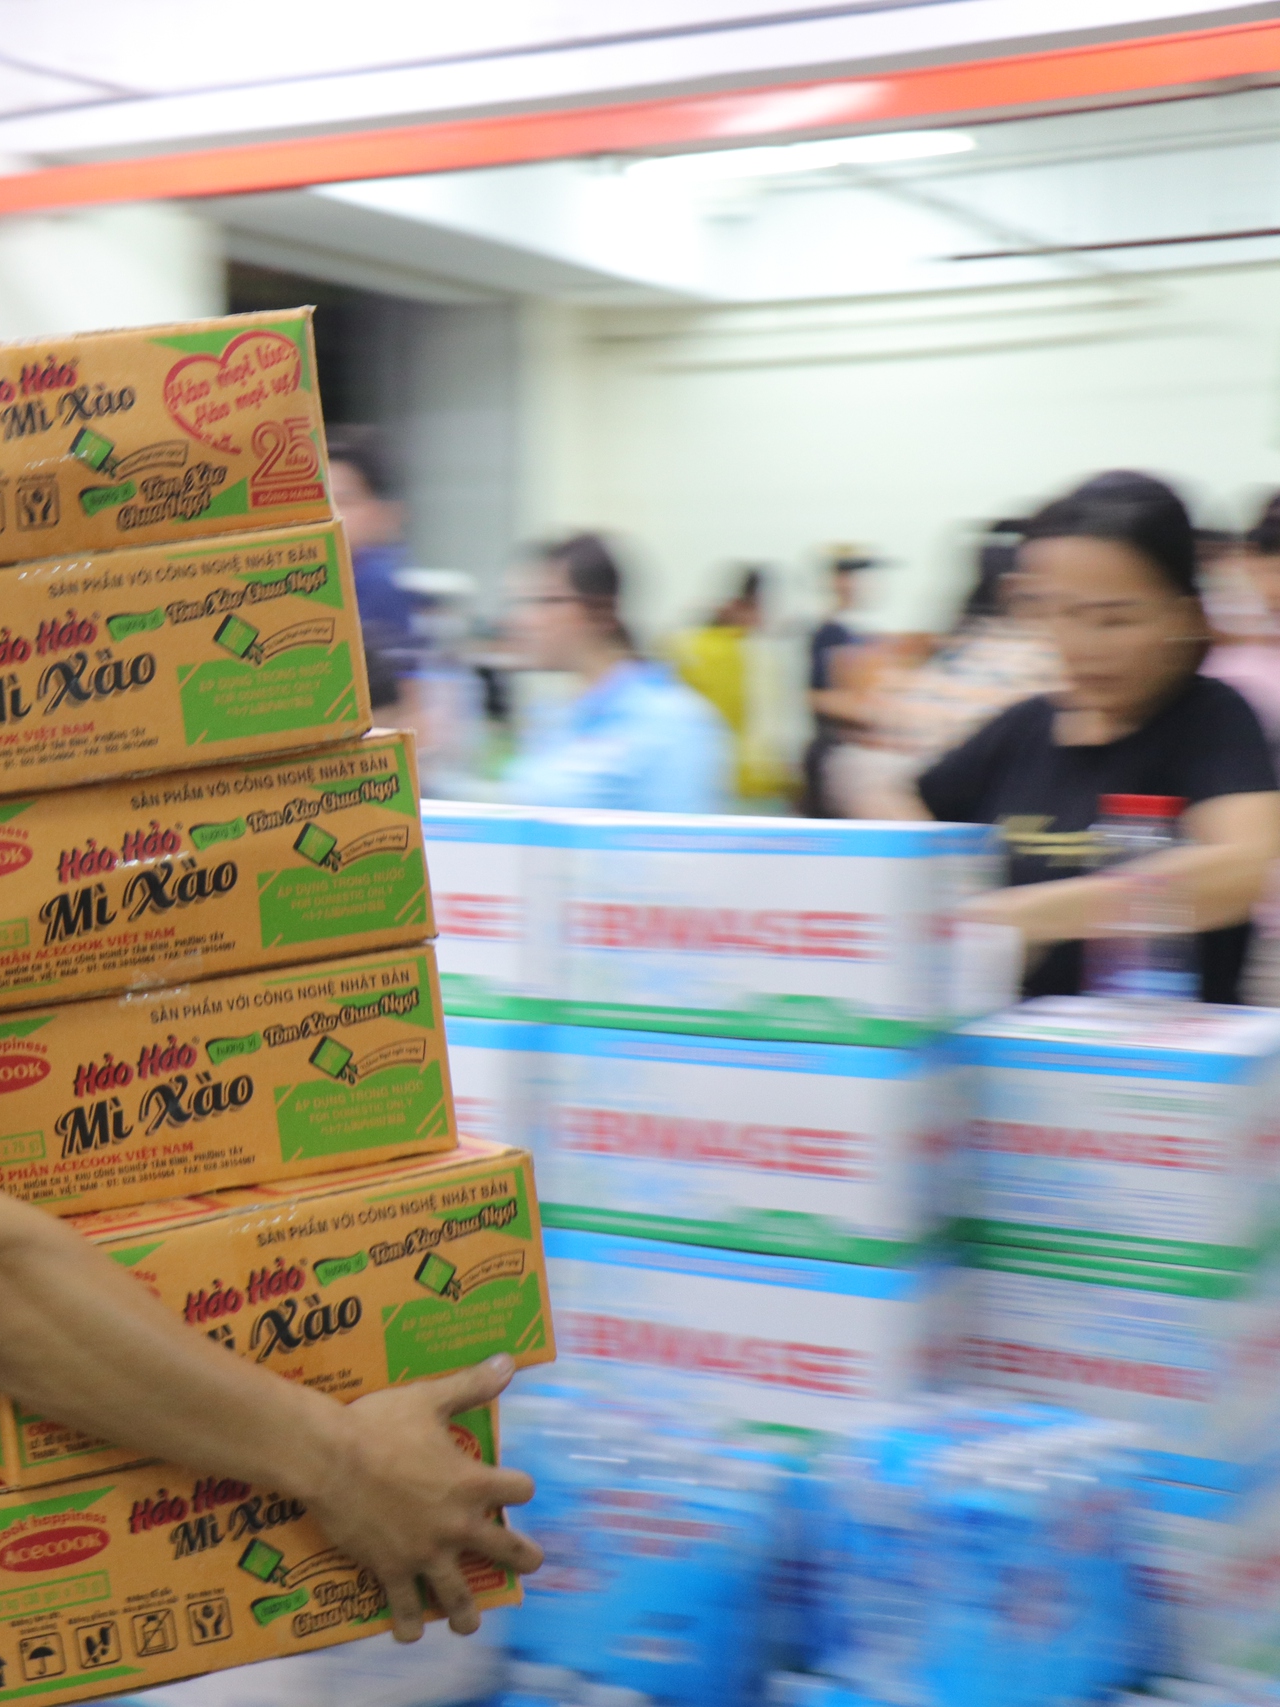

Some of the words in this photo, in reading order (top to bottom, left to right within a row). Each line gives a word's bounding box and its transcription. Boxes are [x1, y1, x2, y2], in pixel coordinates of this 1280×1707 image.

[20, 353, 80, 397] Hảo
[56, 382, 138, 429] Xào
[250, 416, 319, 490] 25
[155, 560, 197, 584] CÔNG
[36, 608, 99, 657] Hảo
[36, 648, 157, 715] Xào
[131, 791, 161, 811] SẢN
[164, 782, 204, 806] PHẨM
[207, 779, 231, 799] VỚI
[234, 774, 272, 793] CÔNG
[277, 768, 315, 786] NGHỆ
[319, 762, 356, 780] NHẬT
[360, 755, 388, 771] BẢN
[247, 808, 285, 834] Tôm
[283, 797, 322, 824] Xào
[320, 787, 362, 813] Chua
[359, 773, 400, 804] Ngọt
[58, 838, 119, 884] Hảo
[121, 820, 182, 863] Hảo
[39, 882, 118, 946] Mì
[122, 857, 239, 922] Xào
[107, 930, 139, 948] VIỆT
[143, 925, 176, 940] NAM
[150, 1003, 180, 1025] SẢN
[183, 995, 223, 1018] PHẨM
[227, 992, 251, 1012] VỚI
[254, 988, 294, 1007] CÔNG
[298, 981, 337, 1002] NGHỆ
[341, 973, 377, 994] NHẬT
[381, 968, 411, 985] BẢN
[263, 1022, 301, 1048] Tôm
[299, 1010, 339, 1039] Xào
[338, 999, 382, 1027] Chua
[379, 985, 420, 1016] Ngọt
[73, 1052, 135, 1099] Hảo
[137, 1034, 198, 1079] Hảo
[54, 1096, 135, 1160] Mì
[138, 1070, 255, 1137] Xào
[349, 1087, 389, 1104] TRONG
[7, 1162, 50, 1181] PHẦN
[53, 1154, 123, 1176] ACECOOK
[125, 1146, 158, 1164] VIỆT
[162, 1139, 195, 1155] NAM
[256, 1226, 286, 1248] SẢN
[289, 1216, 329, 1241] PHẨM
[333, 1211, 355, 1231] VỚI
[358, 1205, 398, 1225] CÔNG
[400, 1196, 439, 1220] NGHỆ
[442, 1187, 477, 1209] NHẬT
[481, 1180, 509, 1199] BẢN
[369, 1241, 406, 1267] Tôm
[404, 1227, 442, 1254] Xào
[441, 1216, 483, 1242] Chua
[479, 1198, 519, 1229] Ngọt
[183, 1278, 245, 1327] Hảo
[246, 1256, 307, 1306] Hảo
[250, 1293, 363, 1364] Xào
[31, 1508, 108, 1528] happiness
[128, 1488, 190, 1535] Hảo
[170, 1513, 225, 1561] Mì
[313, 1579, 357, 1607] Tôm
[291, 1605, 345, 1638] Chua
